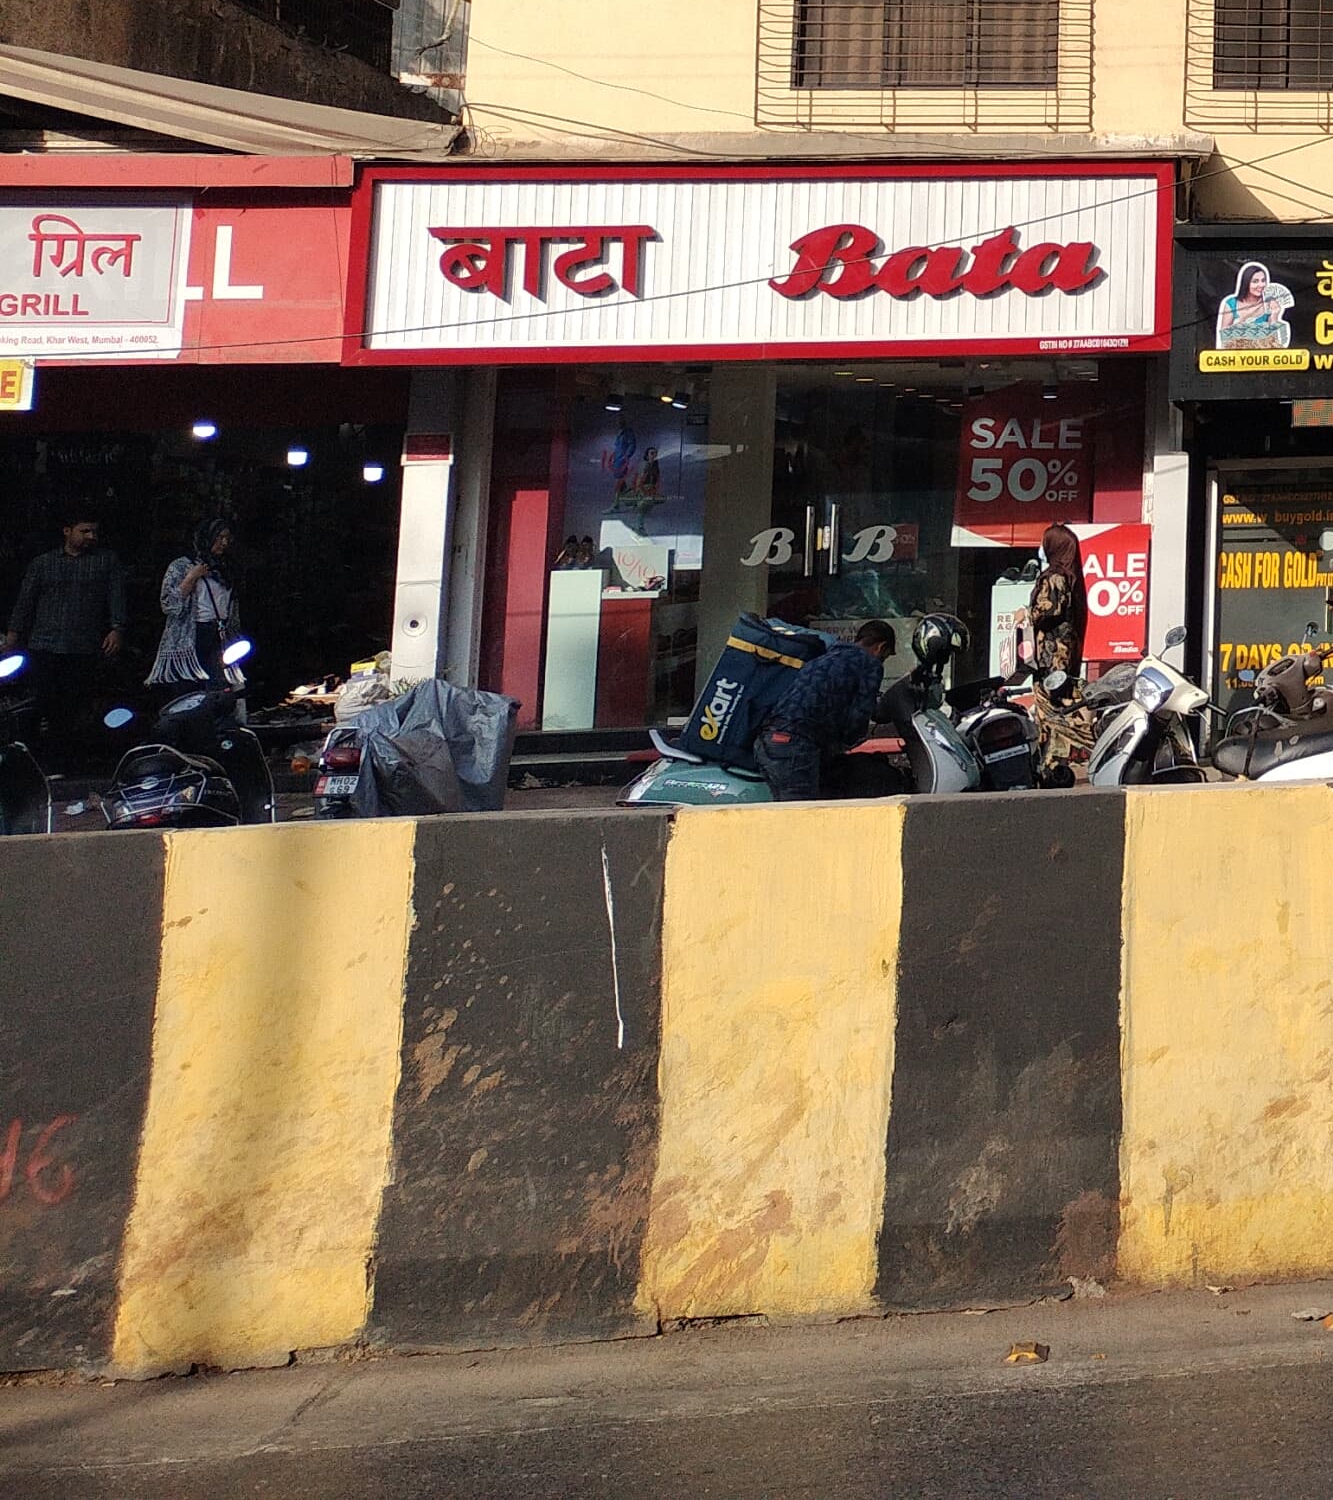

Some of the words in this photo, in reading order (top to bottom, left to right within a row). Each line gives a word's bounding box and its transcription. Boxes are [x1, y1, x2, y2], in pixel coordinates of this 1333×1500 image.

[28, 214, 141, 277] ग्रिल
[768, 222, 1108, 300] Bata
[427, 225, 662, 305] बाटा
[0, 293, 89, 316] GRILL
[46, 336, 66, 344] Khar
[68, 336, 90, 344] West,
[92, 336, 123, 344] Mumbai
[1206, 354, 1235, 367] CASH
[1239, 354, 1269, 366] YOUR
[1273, 353, 1303, 365] GOLD
[969, 417, 1082, 450] SALE
[967, 458, 1078, 501] 50%
[1045, 491, 1079, 501] OFF
[1083, 553, 1146, 577] ALE
[1219, 552, 1252, 589] CASH
[1254, 552, 1280, 588] FOR
[1284, 551, 1317, 588] GOLD
[1087, 581, 1144, 616] 0%
[1117, 605, 1145, 615] OFF
[1220, 644, 1233, 672] 7
[1236, 644, 1282, 670] DAYS
[700, 677, 739, 741] ekart
